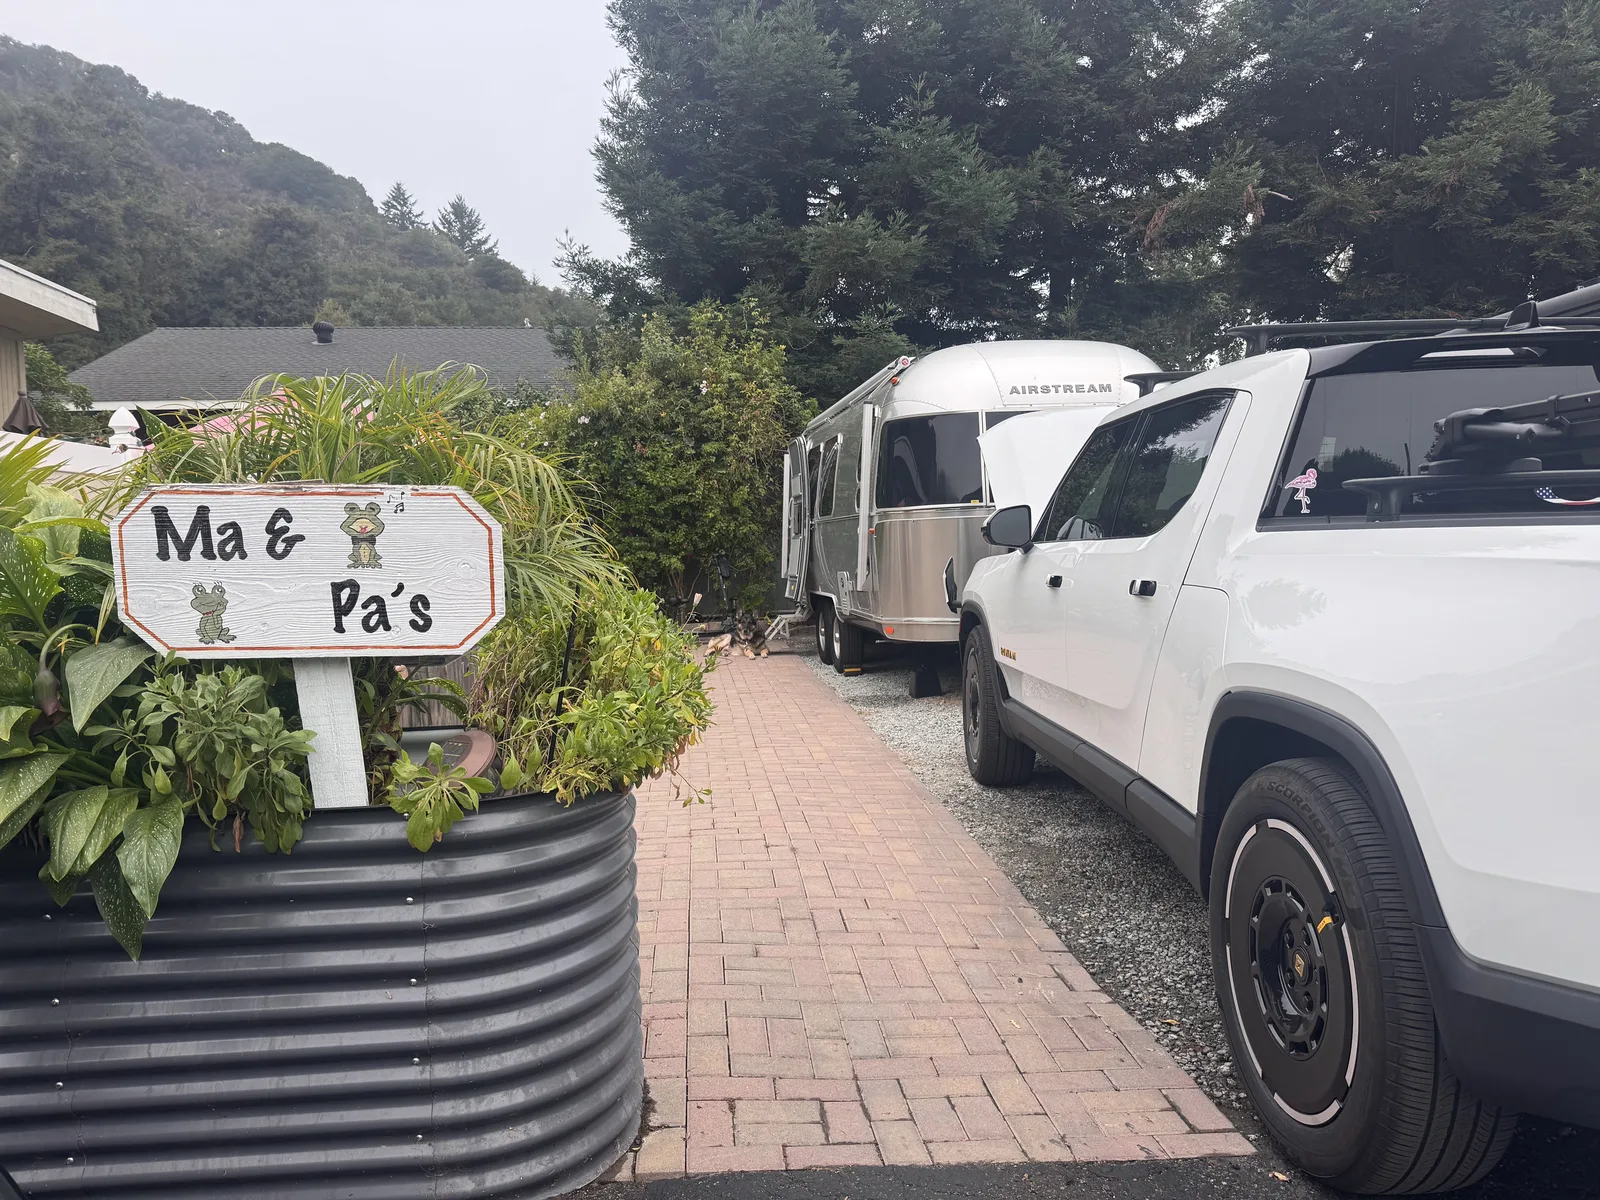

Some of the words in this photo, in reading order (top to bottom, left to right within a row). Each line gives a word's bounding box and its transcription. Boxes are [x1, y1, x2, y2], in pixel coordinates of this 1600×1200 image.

[1009, 383, 1112, 395] AIRSTREAM
[150, 505, 248, 562] Ma
[265, 507, 306, 561] &
[330, 578, 433, 634] Pa's
[1267, 781, 1335, 849] SCORPION
